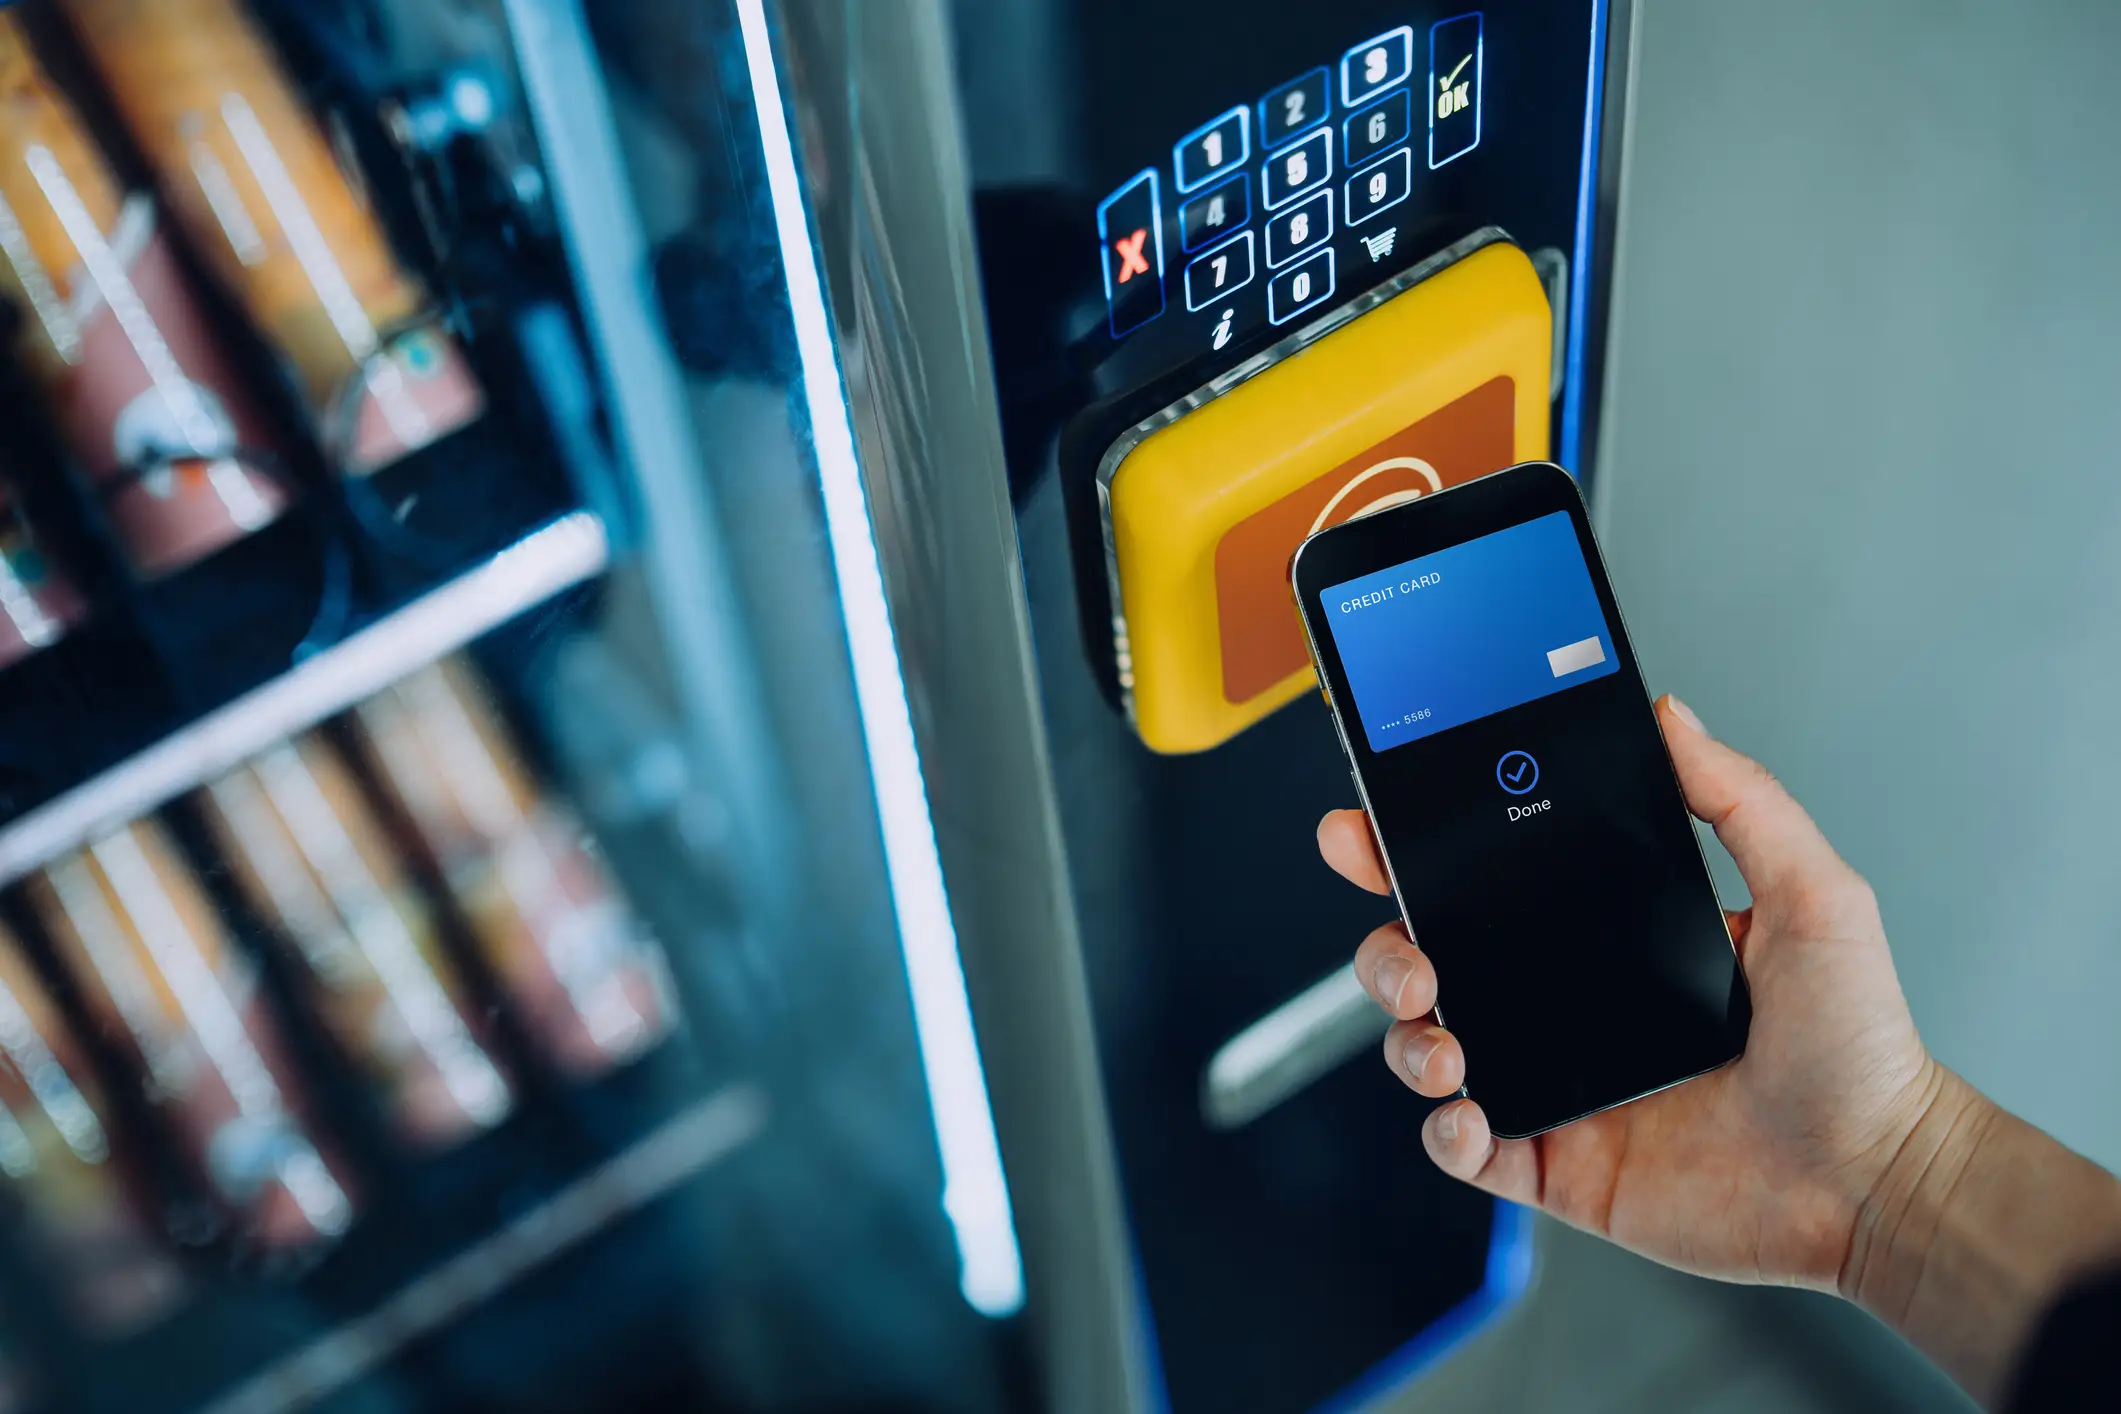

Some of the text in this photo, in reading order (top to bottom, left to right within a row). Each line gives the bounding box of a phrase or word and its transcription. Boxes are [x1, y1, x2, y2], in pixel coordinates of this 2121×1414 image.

[1365, 47, 1388, 83] 3
[1285, 90, 1306, 126] 2
[1437, 82, 1469, 118] OK
[1369, 112, 1386, 143] 6
[1203, 130, 1222, 166] 1
[1287, 152, 1308, 186] 5
[1369, 172, 1387, 203] 9
[1206, 194, 1226, 227] 4
[1290, 212, 1309, 245] 8
[1211, 256, 1228, 288] 7
[1341, 572, 1440, 613] CREDIT CARD
[1404, 708, 1431, 724] 5586
[1507, 799, 1551, 822] Done
